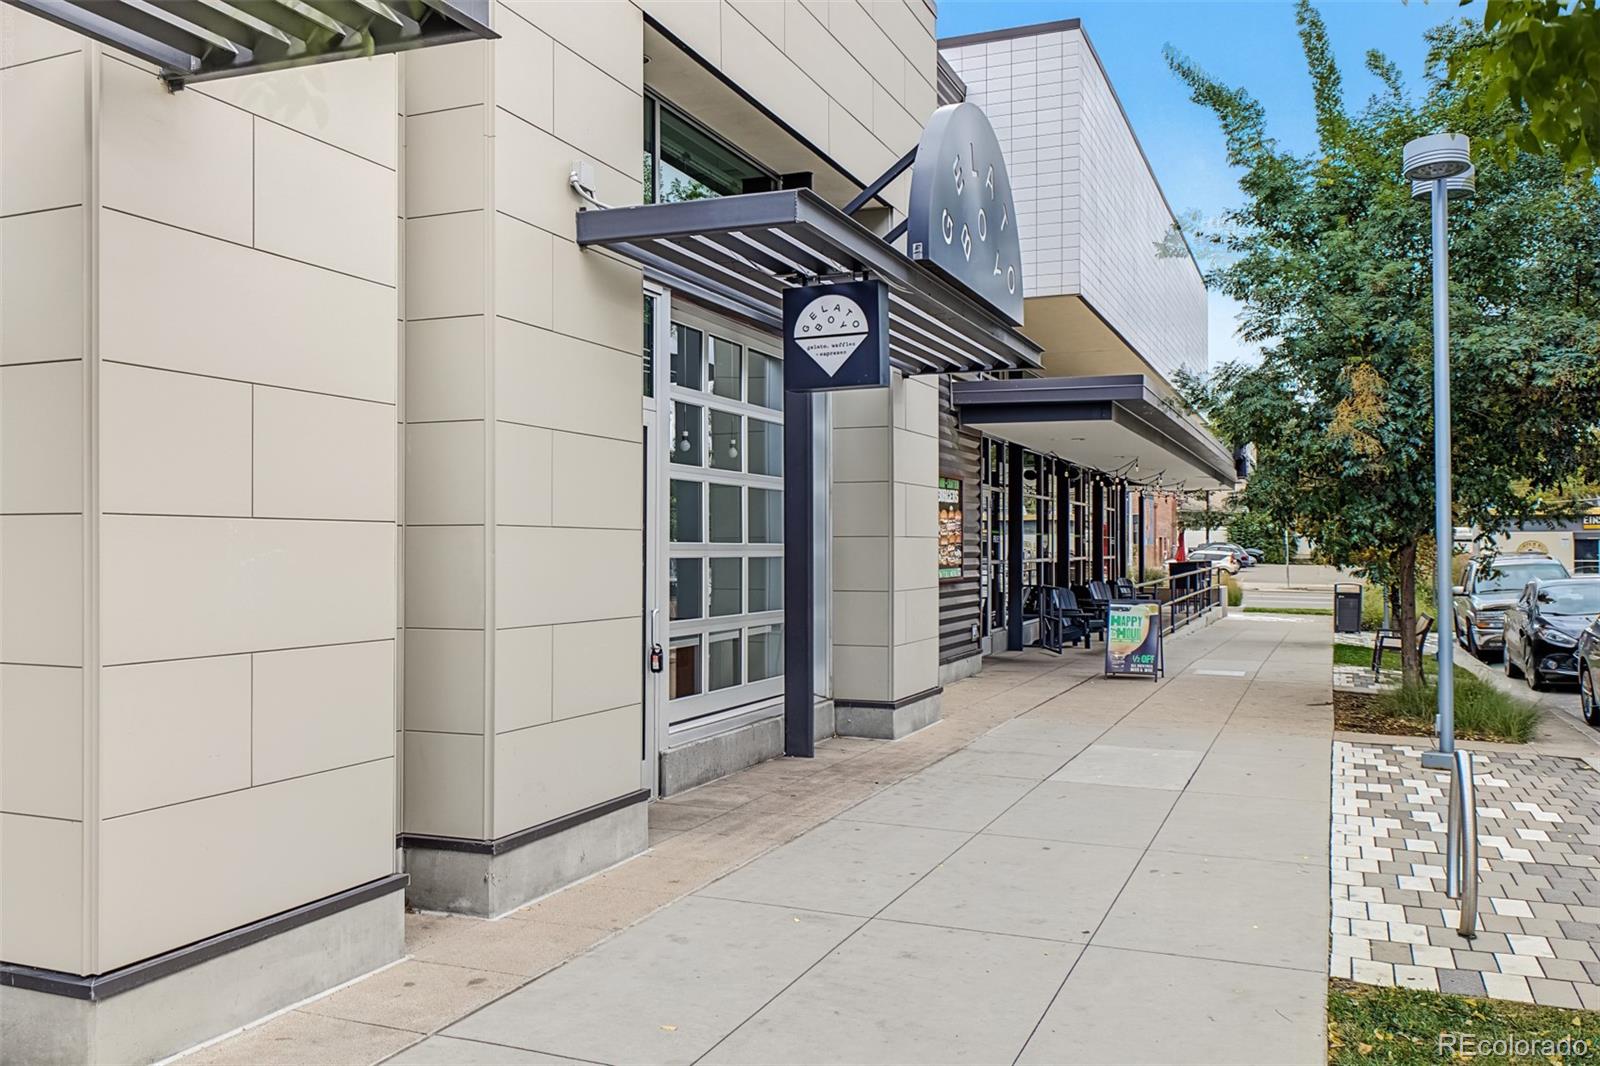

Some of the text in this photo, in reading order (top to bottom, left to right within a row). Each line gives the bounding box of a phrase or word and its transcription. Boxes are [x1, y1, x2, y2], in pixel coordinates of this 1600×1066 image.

[942, 142, 1016, 294] GELATO
[961, 208, 1002, 276] BOY
[802, 304, 860, 332] GELATO
[815, 315, 847, 332] BOY
[1111, 616, 1142, 626] HAPPY
